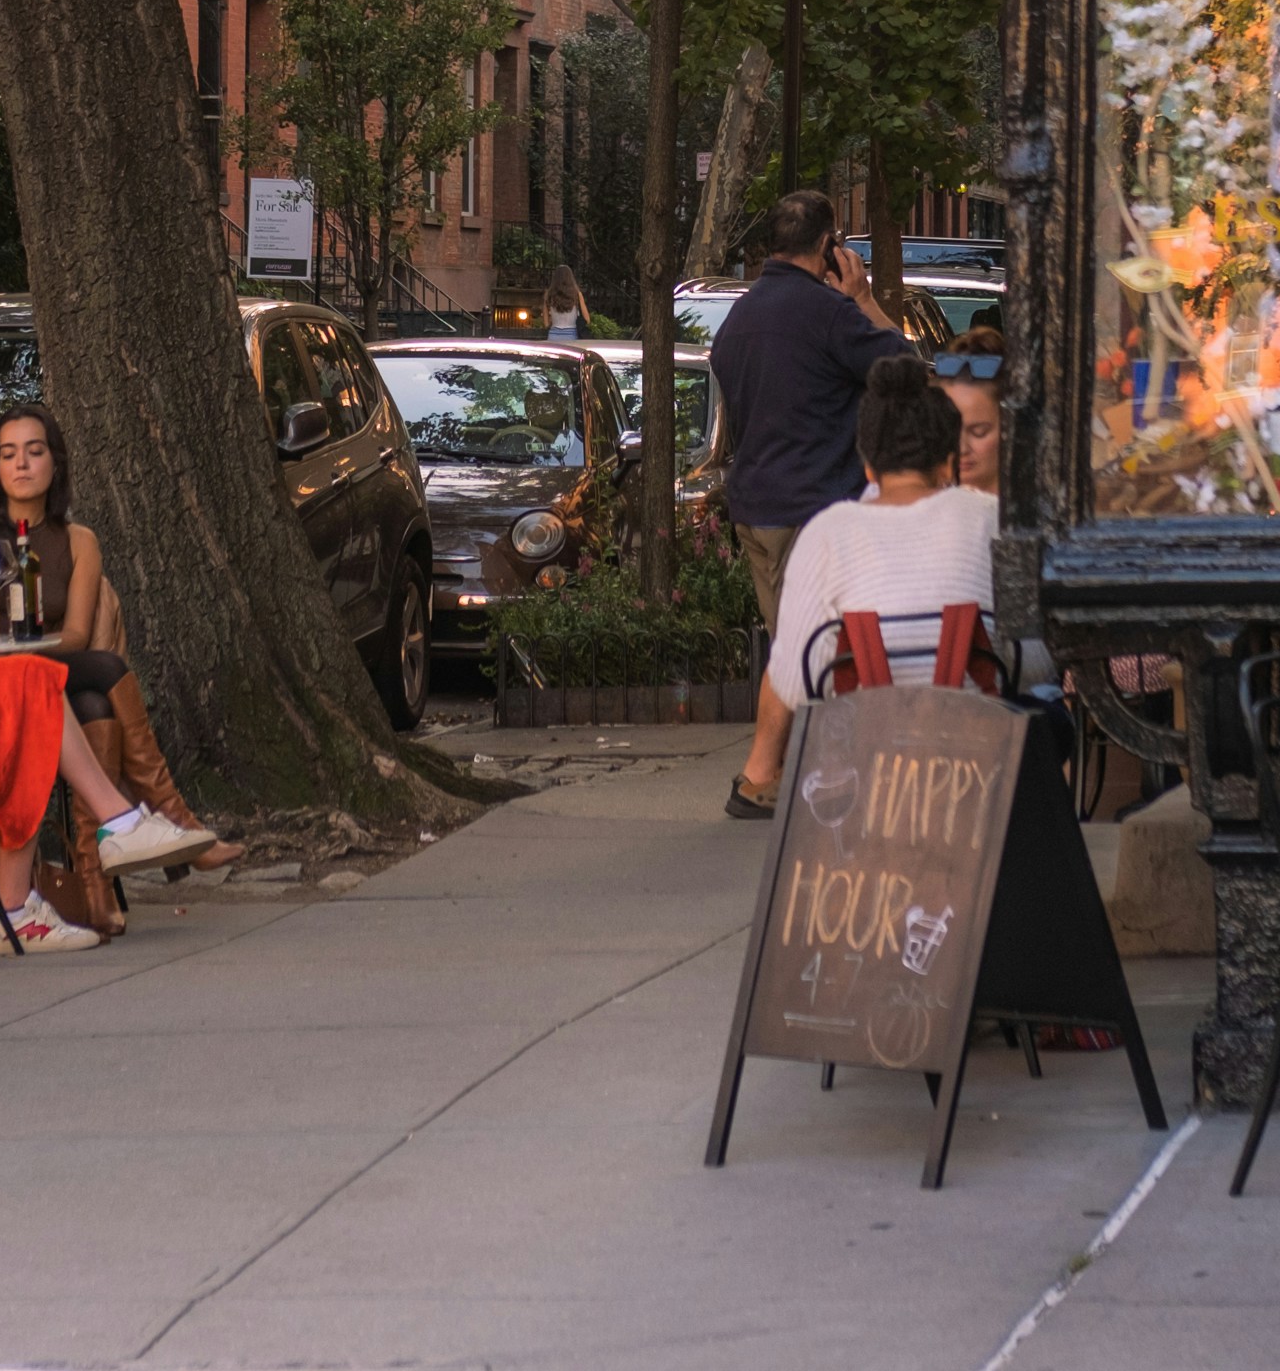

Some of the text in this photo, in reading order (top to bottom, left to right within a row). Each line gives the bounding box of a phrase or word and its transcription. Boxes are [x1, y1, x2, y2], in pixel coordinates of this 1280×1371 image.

[255, 199, 302, 214] For Sale
[866, 750, 1002, 850] HAPPY
[782, 859, 914, 960] HOUR
